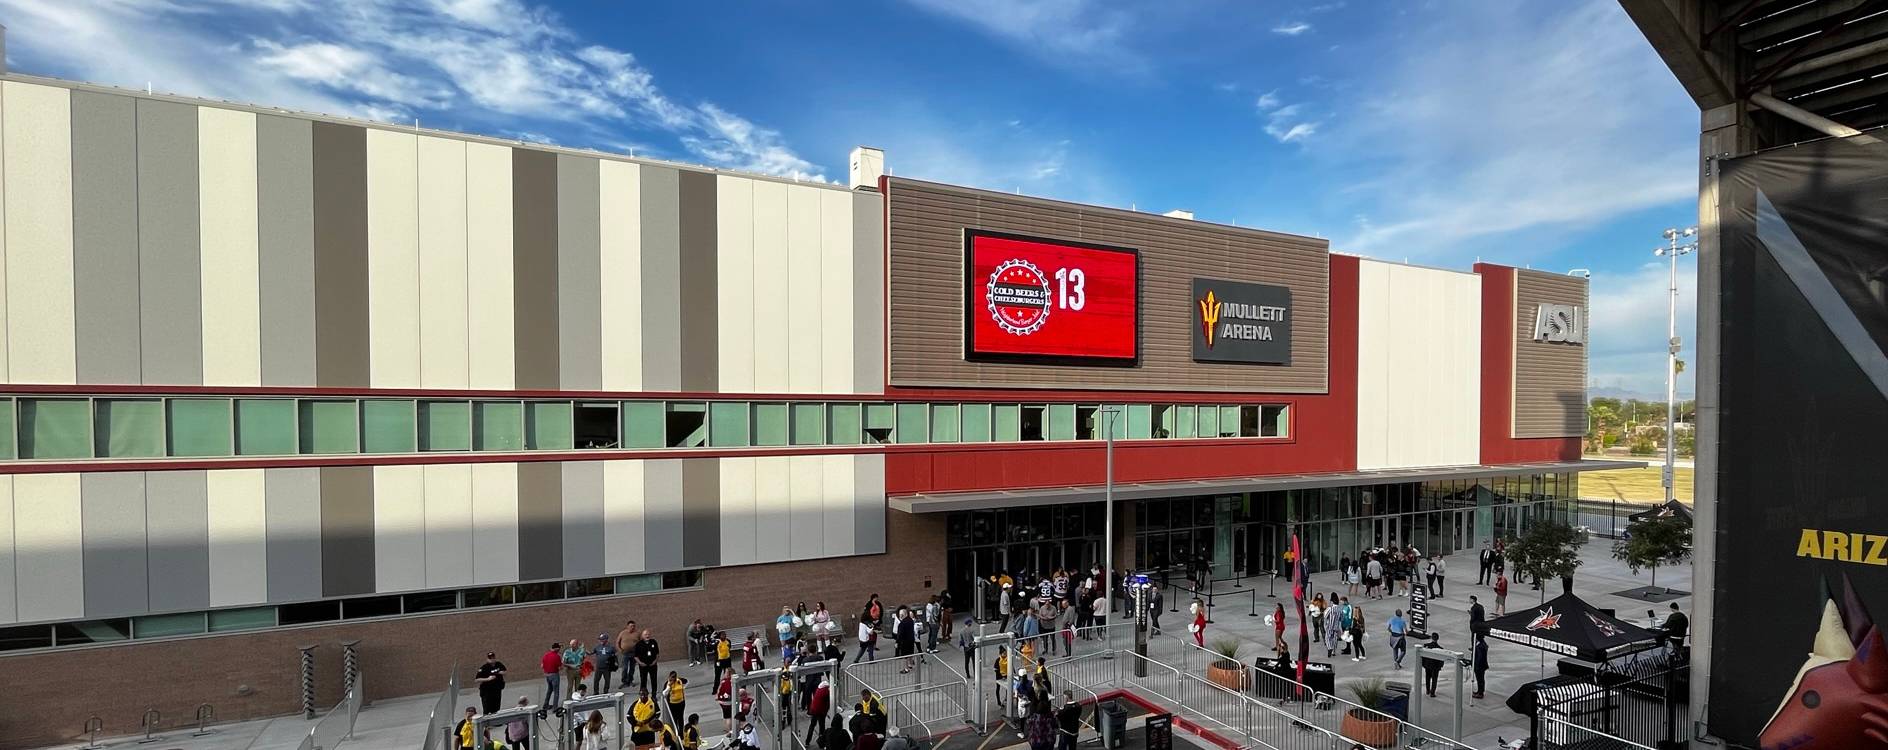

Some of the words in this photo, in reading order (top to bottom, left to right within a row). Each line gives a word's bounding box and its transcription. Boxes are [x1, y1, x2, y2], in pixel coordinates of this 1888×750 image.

[994, 287, 1014, 295] COLD
[1015, 289, 1039, 297] BEERS
[994, 295, 1045, 304] CHEESEBURGERS
[1055, 267, 1085, 311] 13
[1223, 302, 1286, 321] MULLETT
[1534, 303, 1584, 343] ASU
[1222, 323, 1273, 341] ARENA
[1796, 528, 1888, 566] ARIZ
[1489, 627, 1530, 645] ARIZONA
[1531, 635, 1578, 657] COYOTES
